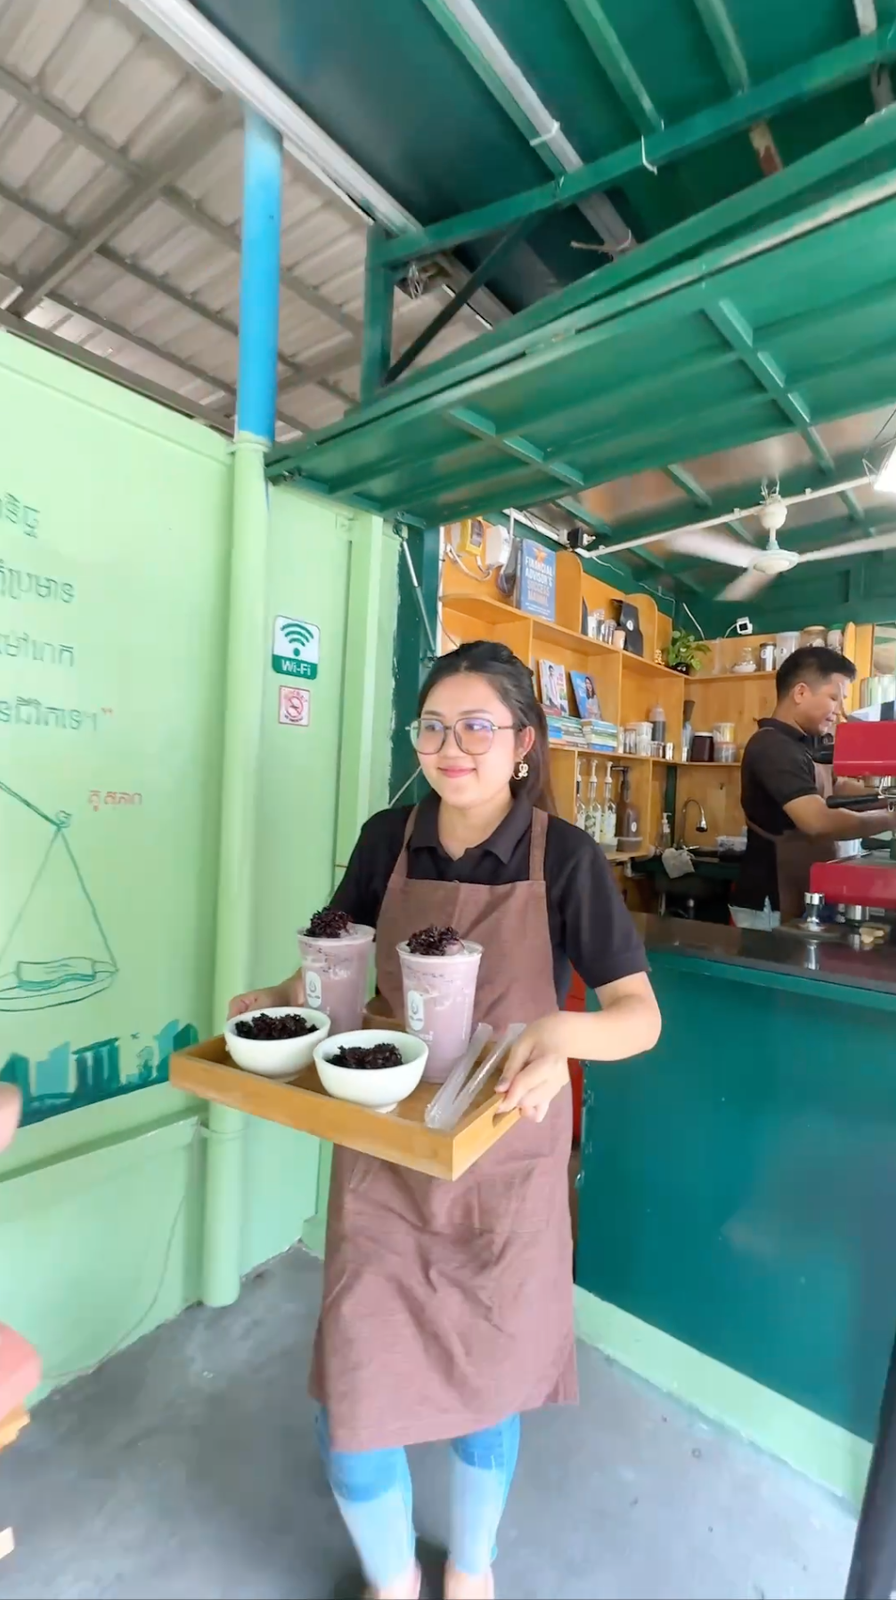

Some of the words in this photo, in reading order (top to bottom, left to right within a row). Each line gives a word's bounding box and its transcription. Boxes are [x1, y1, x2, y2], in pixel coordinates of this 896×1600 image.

[525, 556, 553, 576] FINANCIAL
[525, 568, 553, 587] ADVISOR'S
[281, 659, 311, 676] Wi-Fi
